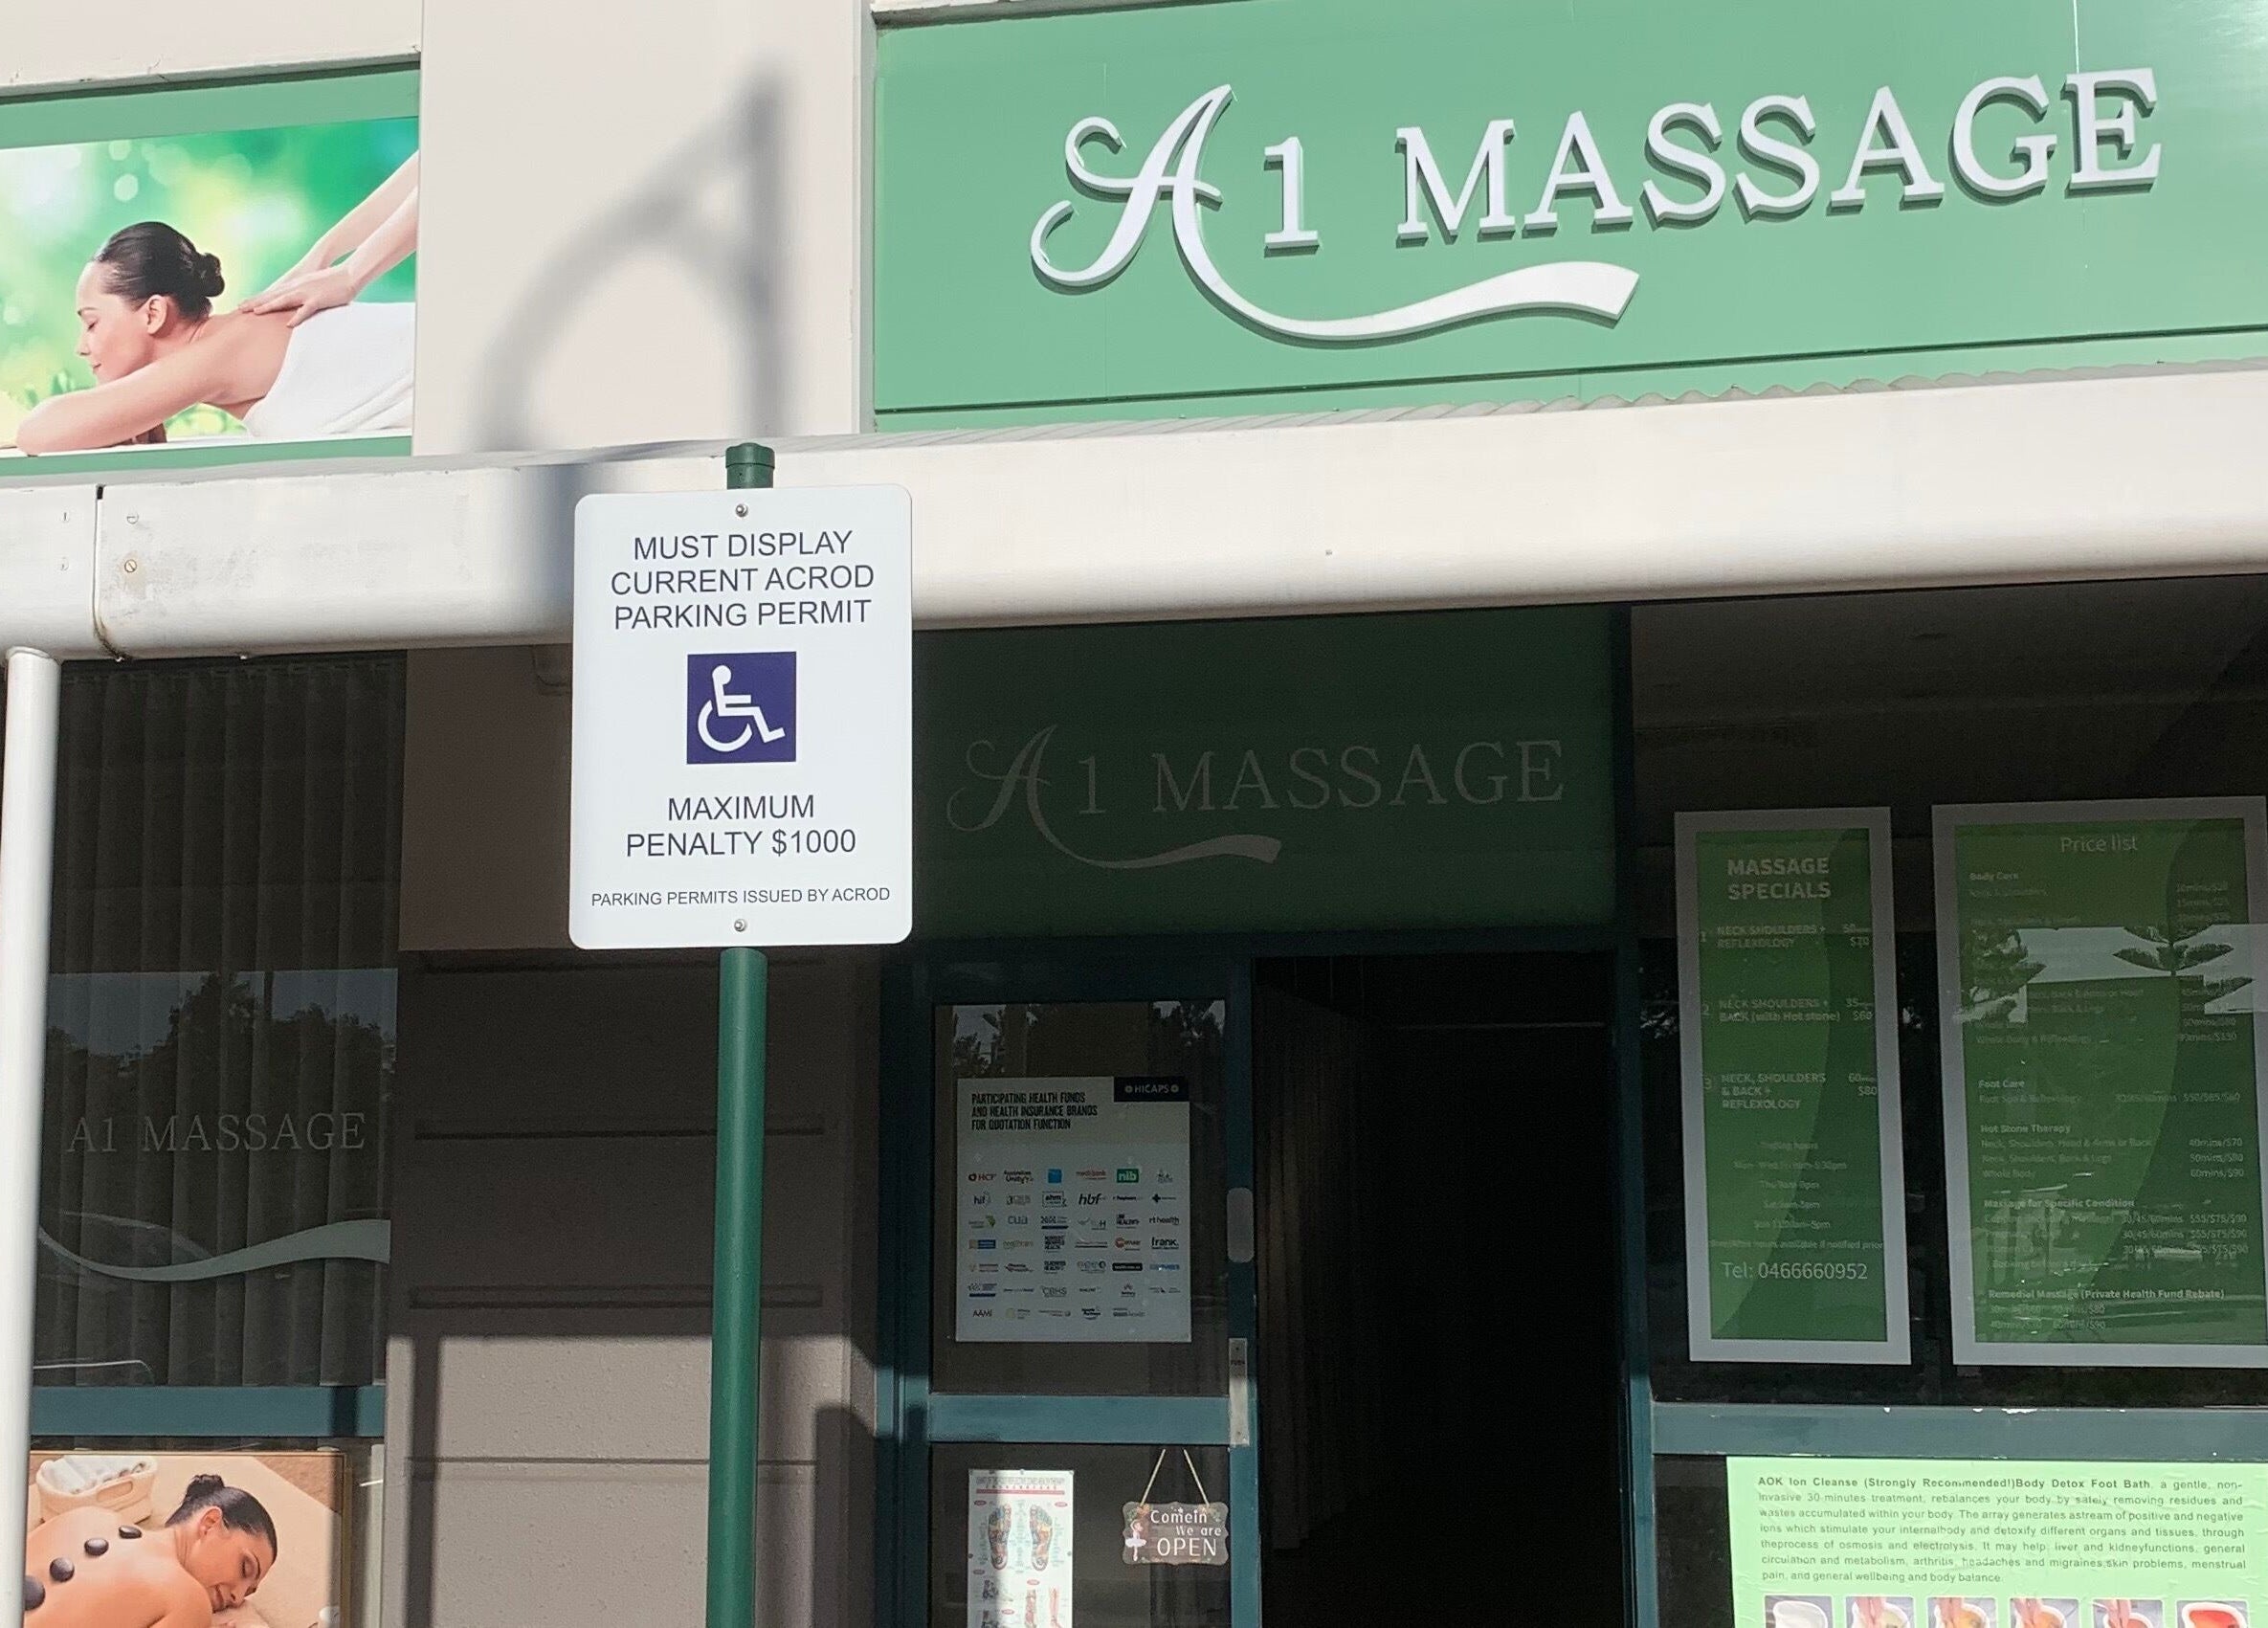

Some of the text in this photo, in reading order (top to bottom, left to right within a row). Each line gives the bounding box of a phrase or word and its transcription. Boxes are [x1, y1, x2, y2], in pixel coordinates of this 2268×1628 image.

[1395, 66, 2162, 248] MASSAGE
[634, 530, 853, 561] MUST DISPLAY
[611, 565, 874, 596] CURRENT ACROD
[614, 600, 871, 630] PARKING PERMIT
[1151, 740, 1565, 812] MASSAGE
[668, 794, 814, 821] MAXIMUM
[626, 829, 856, 857] PENALTY $1000
[2061, 836, 2137, 853] Price list
[1727, 858, 1829, 876] MASSAGE
[591, 887, 889, 907] PARKING PERMITS ISSUED BY ACROD
[1729, 882, 1831, 900] SPECIALS
[1758, 1074, 1826, 1082] SHOULDERS
[2003, 1080, 2025, 1088] Care
[1135, 1084, 1168, 1093] HICAPS
[972, 1092, 1085, 1104] PARTICIPATING HEALTH FUNDS
[1723, 1100, 1801, 1109] REFLEXOLOGY
[972, 1105, 1097, 1117] AND HEALTH INSURANCE BRANDS
[972, 1119, 1070, 1130] FOR QUOTATION FUNCTION
[66, 1112, 365, 1153] A1 MASSAGE
[1078, 1193, 1101, 1205] hbf
[1722, 1262, 1868, 1279] Tel: 0466660952
[1758, 1477, 1783, 1486] AOK
[1790, 1478, 1807, 1486] Ion
[1812, 1478, 1858, 1487] Cleanse
[1864, 1478, 1916, 1488] (Strongly
[2052, 1479, 2084, 1488] Detox
[2091, 1480, 2118, 1488] Foot
[1824, 1494, 1866, 1503] minutes
[1931, 1495, 1990, 1504] rebalances
[1997, 1496, 2019, 1505] your
[2025, 1495, 2051, 1505] body
[2057, 1495, 2070, 1505] by
[2113, 1496, 2165, 1506] removing
[2169, 1496, 2216, 1505] residues
[2222, 1496, 2242, 1505] and
[1760, 1509, 1795, 1518] wastes
[1798, 1509, 1866, 1519] accumulated
[1868, 1509, 1900, 1519] within
[1901, 1511, 1924, 1520] your
[1959, 1509, 1979, 1519] The
[1982, 1511, 2009, 1522] array
[2012, 1511, 2066, 1522] generates
[2069, 1511, 2113, 1521] astream
[2115, 1511, 2126, 1521] of
[2128, 1511, 2171, 1522] positive
[2173, 1511, 2194, 1521] and
[2196, 1511, 2243, 1523] negative
[1176, 1526, 1221, 1536] We are
[1760, 1525, 1782, 1533] ions
[1786, 1525, 1816, 1533] which
[1820, 1525, 1868, 1534] stimulate
[1872, 1527, 1896, 1535] your
[1993, 1526, 2036, 1537] detoxify
[2040, 1527, 2085, 1536] different
[2089, 1528, 2126, 1538] organs
[2131, 1528, 2151, 1536] and
[2202, 1528, 2245, 1539] through
[1156, 1537, 1217, 1557] OPEN
[1761, 1539, 1819, 1550] theprocess
[1824, 1540, 1834, 1550] of
[1888, 1541, 1908, 1550] and
[1983, 1542, 1990, 1550] It
[1995, 1543, 2017, 1552] may
[2055, 1542, 2078, 1551] liver
[2083, 1543, 2103, 1551] and
[2204, 1544, 2245, 1555] general
[1762, 1555, 1816, 1565] circulation
[1820, 1556, 1840, 1565] and
[1962, 1557, 2021, 1568] headaches
[2025, 1558, 2045, 1567] and
[2191, 1559, 2246, 1570] menstrual
[1790, 1572, 1811, 1581] and
[1812, 1572, 1853, 1582] general
[1856, 1572, 1905, 1583] wellbeing
[1907, 1573, 1927, 1582] and
[1930, 1573, 1956, 1584] body
